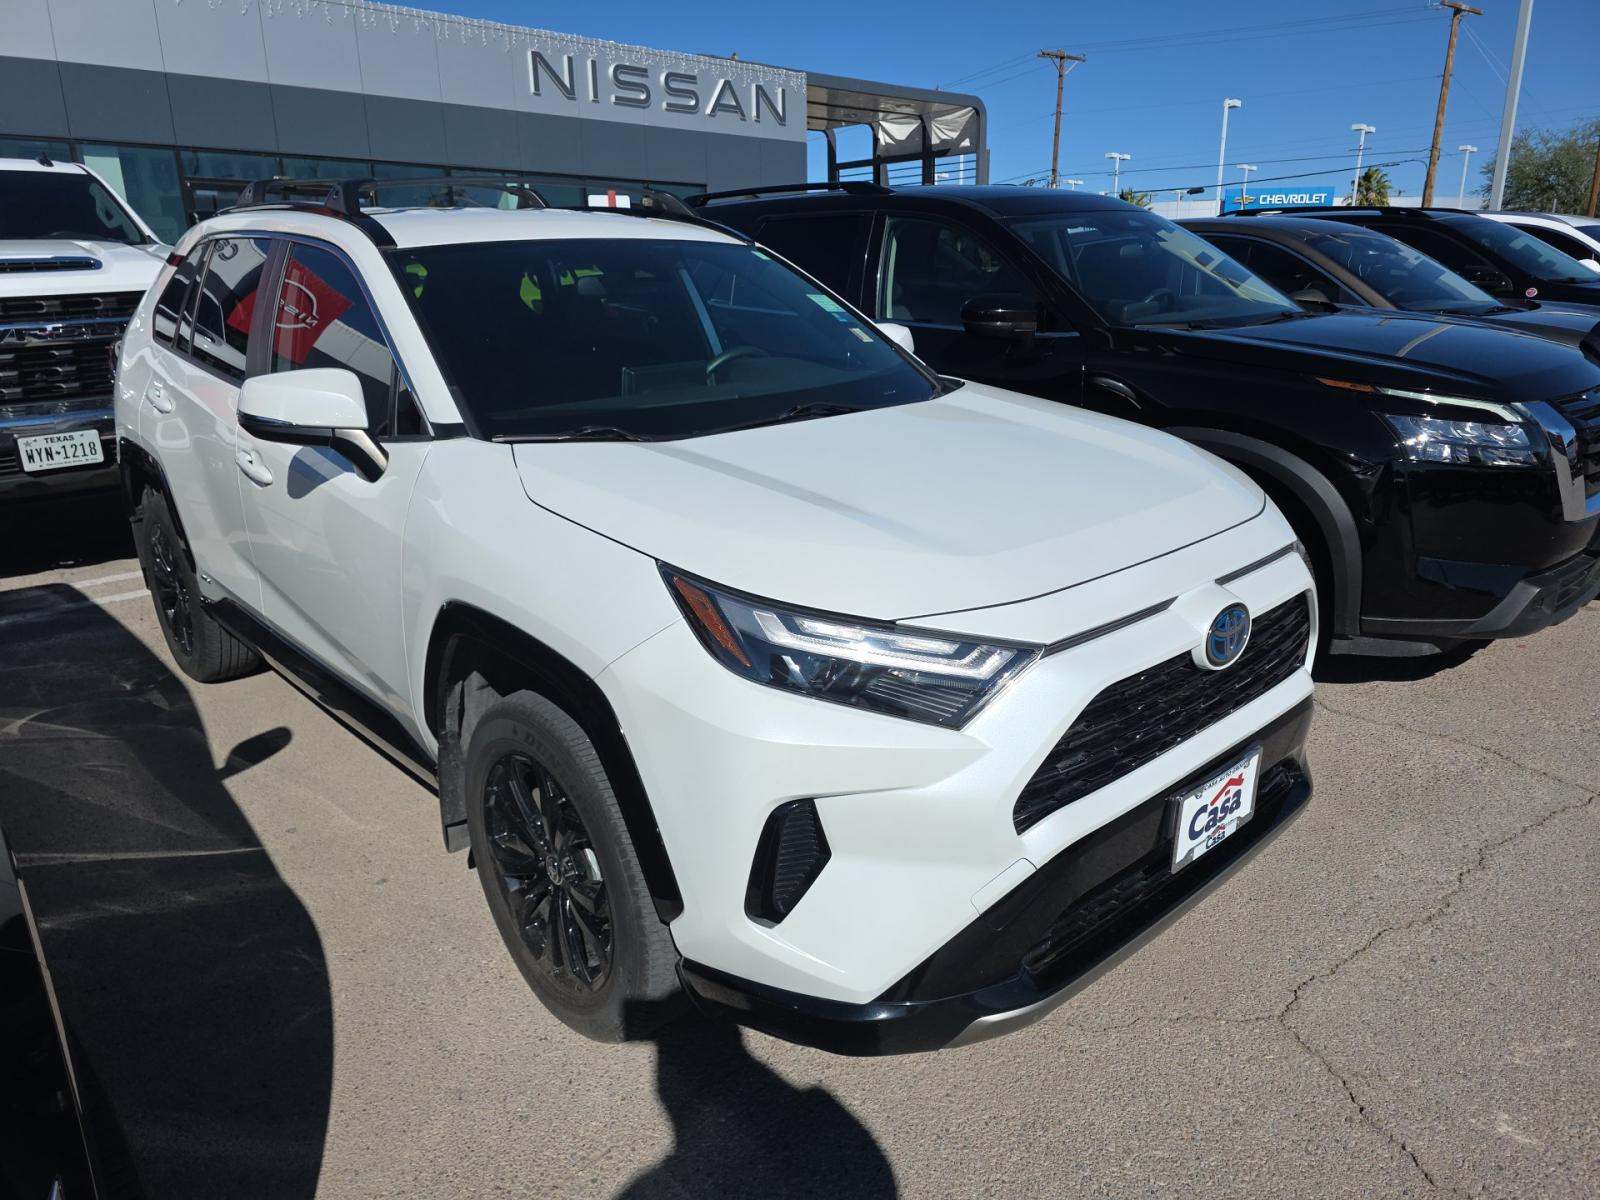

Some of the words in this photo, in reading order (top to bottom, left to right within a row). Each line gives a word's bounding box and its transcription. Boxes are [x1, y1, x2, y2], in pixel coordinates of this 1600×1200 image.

[528, 50, 787, 127] NISSAN
[1260, 193, 1327, 205] CHEVROLET
[44, 434, 75, 444] TEXAS
[1188, 788, 1242, 841] Casa
[1205, 830, 1226, 850] Casa
